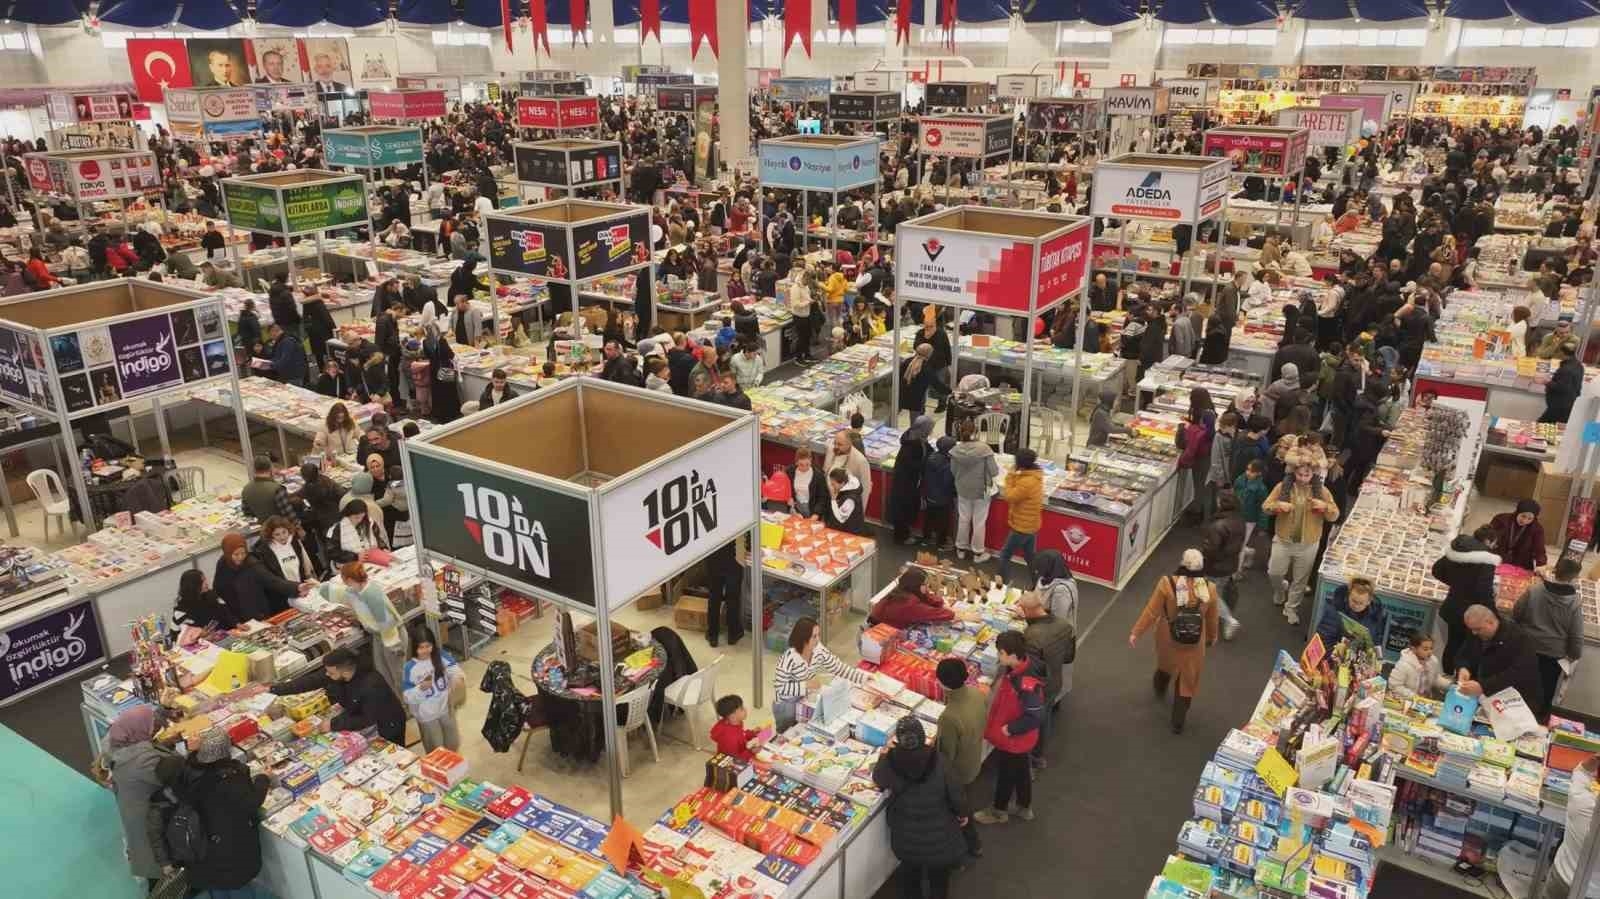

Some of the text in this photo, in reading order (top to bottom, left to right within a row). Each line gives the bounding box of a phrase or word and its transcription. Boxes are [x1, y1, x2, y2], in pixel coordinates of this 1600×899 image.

[1108, 95, 1152, 114] KAVİM
[1126, 187, 1171, 200] ADEDA
[120, 352, 171, 377] indigo
[457, 483, 512, 529] 10
[642, 475, 688, 529] 10
[663, 494, 718, 556] ON
[482, 523, 551, 579] ON
[12, 629, 49, 649] okumak
[8, 640, 83, 682] indigo
